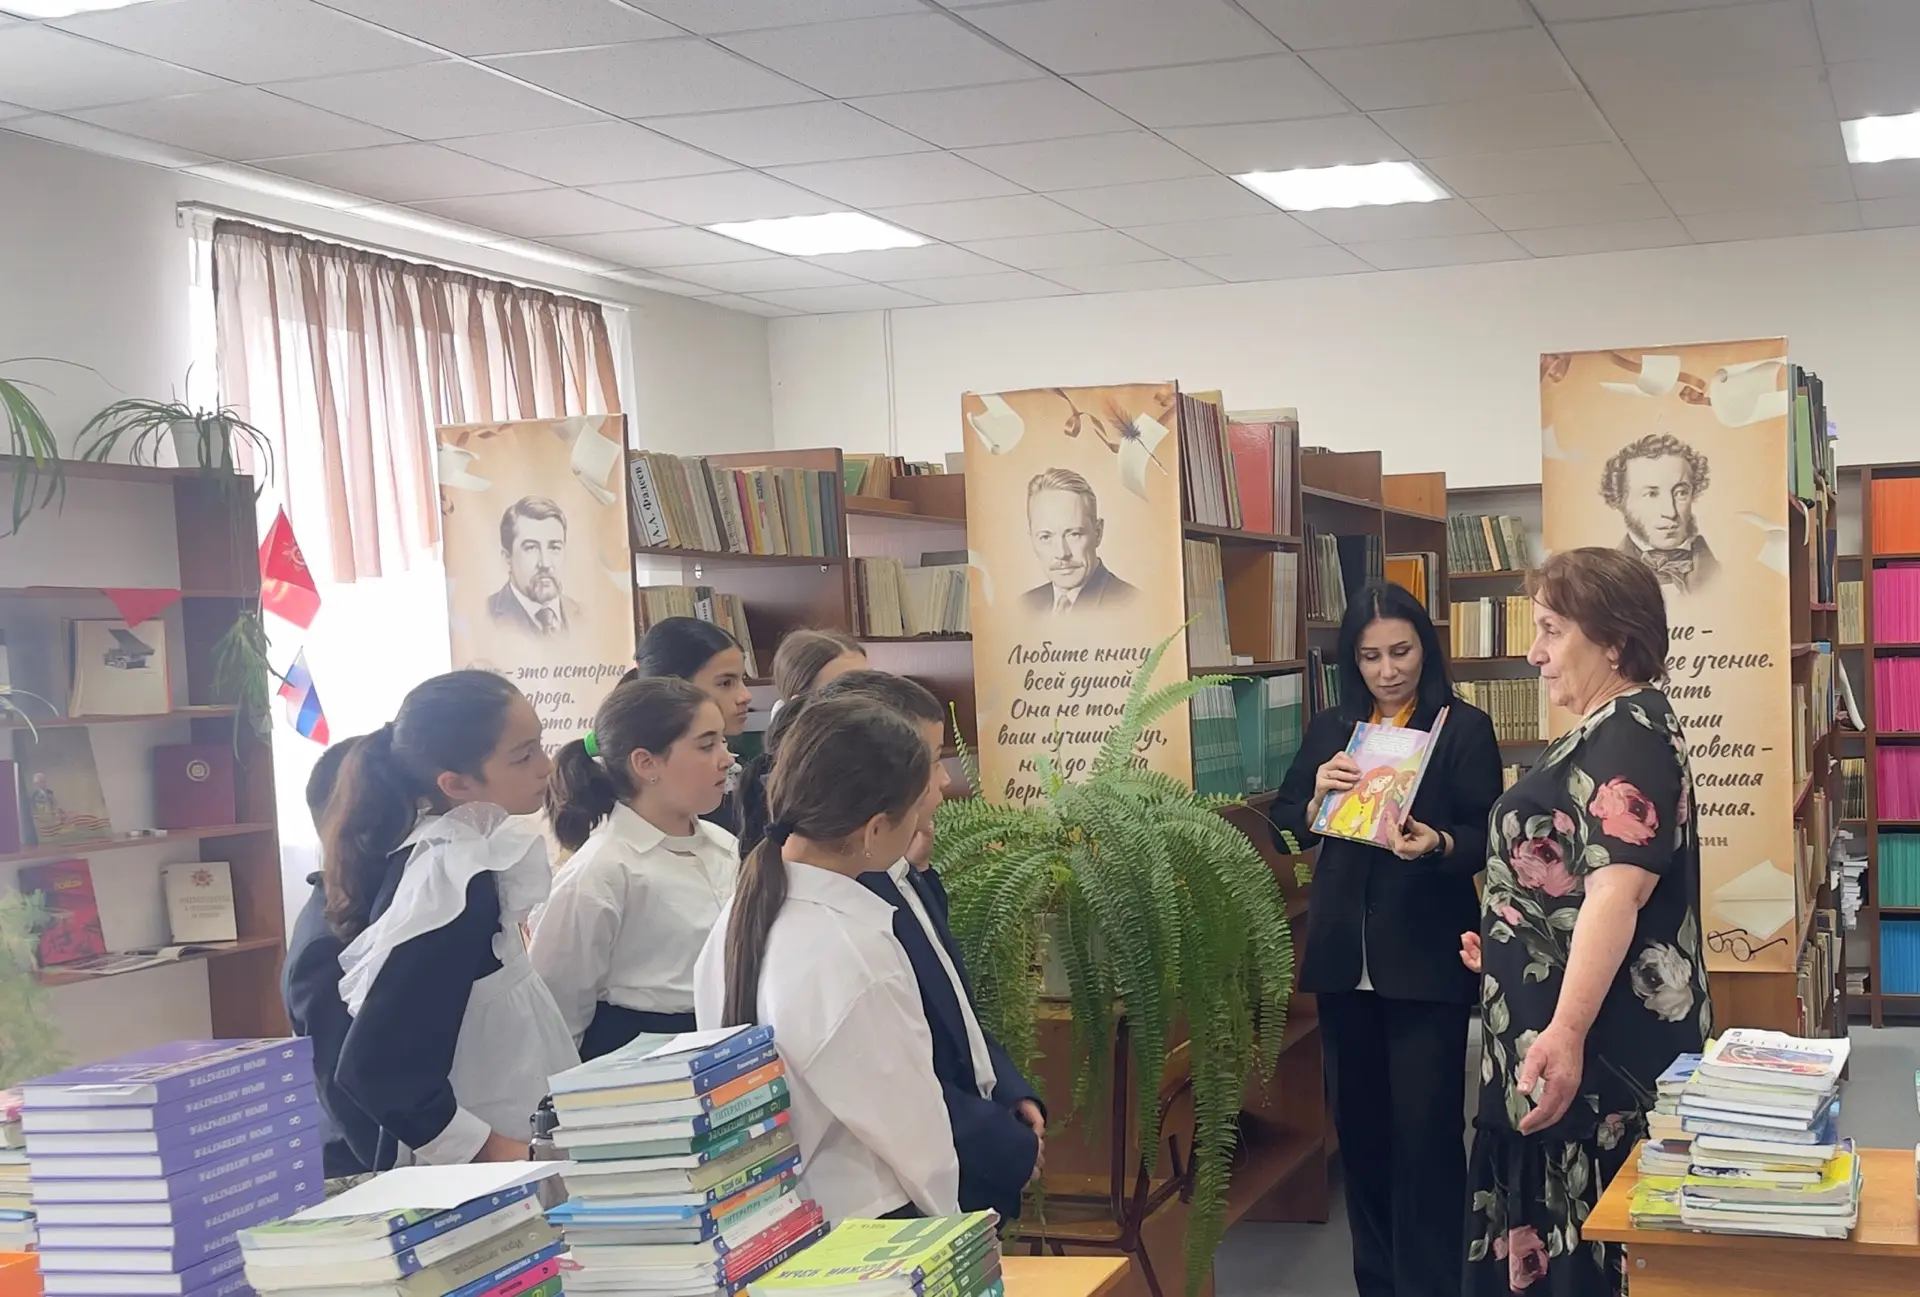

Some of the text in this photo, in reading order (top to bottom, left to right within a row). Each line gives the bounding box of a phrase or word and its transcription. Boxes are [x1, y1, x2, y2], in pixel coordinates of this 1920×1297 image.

[1007, 641, 1151, 669] Любите книгу
[1688, 652, 1774, 679] учение.
[516, 667, 549, 680] это
[552, 663, 627, 684] история
[1024, 669, 1067, 691] всей
[525, 691, 576, 712] арода.
[1010, 698, 1125, 720] Она не тол
[541, 717, 573, 730] это
[998, 724, 1036, 745] ваш
[1136, 729, 1168, 753] уг,
[1687, 734, 1756, 758] ловека
[1063, 758, 1086, 779] до
[1695, 772, 1764, 787] самая
[1005, 777, 1072, 806] верн
